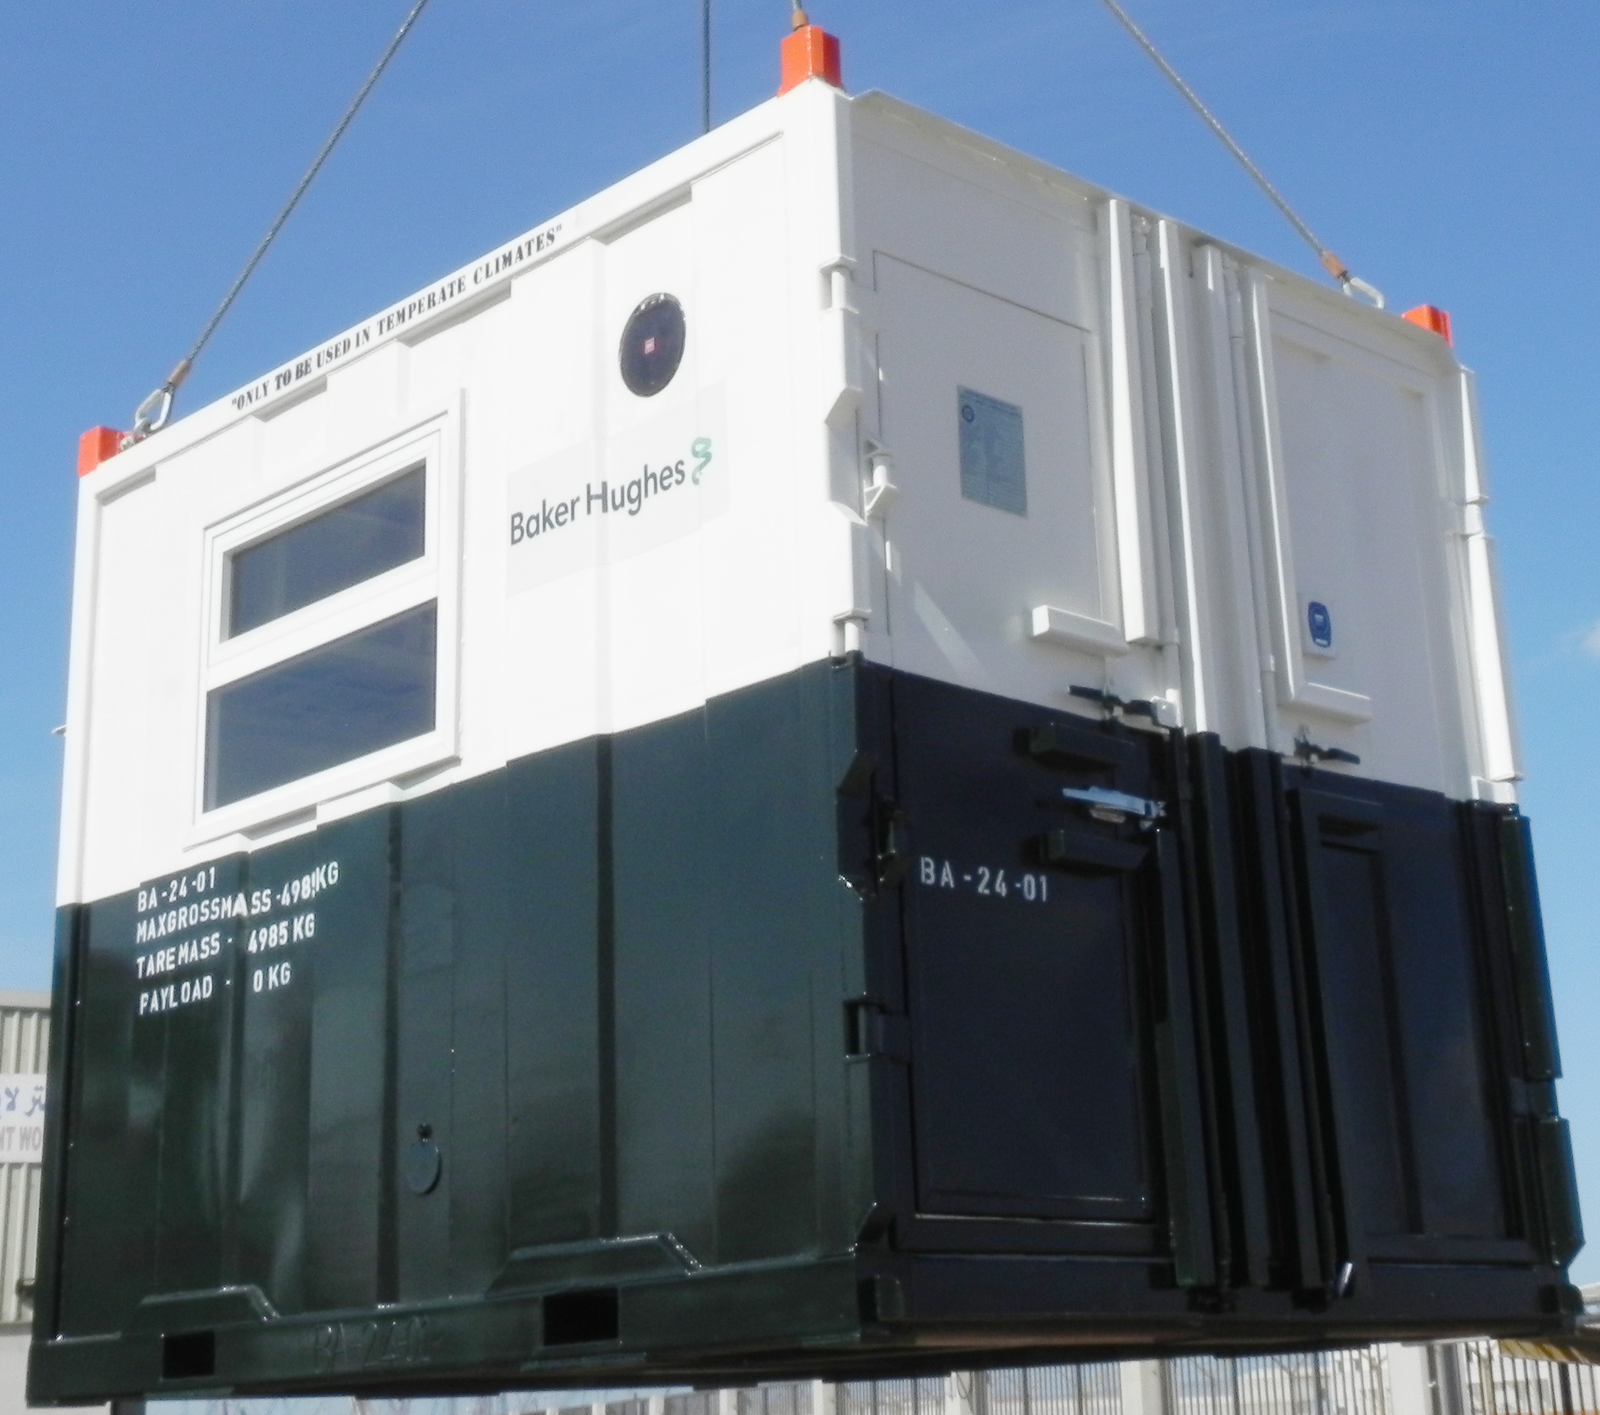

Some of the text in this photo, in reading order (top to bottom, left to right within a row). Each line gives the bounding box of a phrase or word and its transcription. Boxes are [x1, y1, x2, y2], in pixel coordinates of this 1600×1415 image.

[232, 224, 562, 411] "ONLY TO BE USED IN TEMPERATE CLIMATES"
[511, 459, 686, 546] Baker Hughes
[248, 921, 289, 954] 4985
[293, 912, 316, 943] KG
[139, 975, 213, 1016] PAYLOAD
[268, 962, 292, 990] KG
